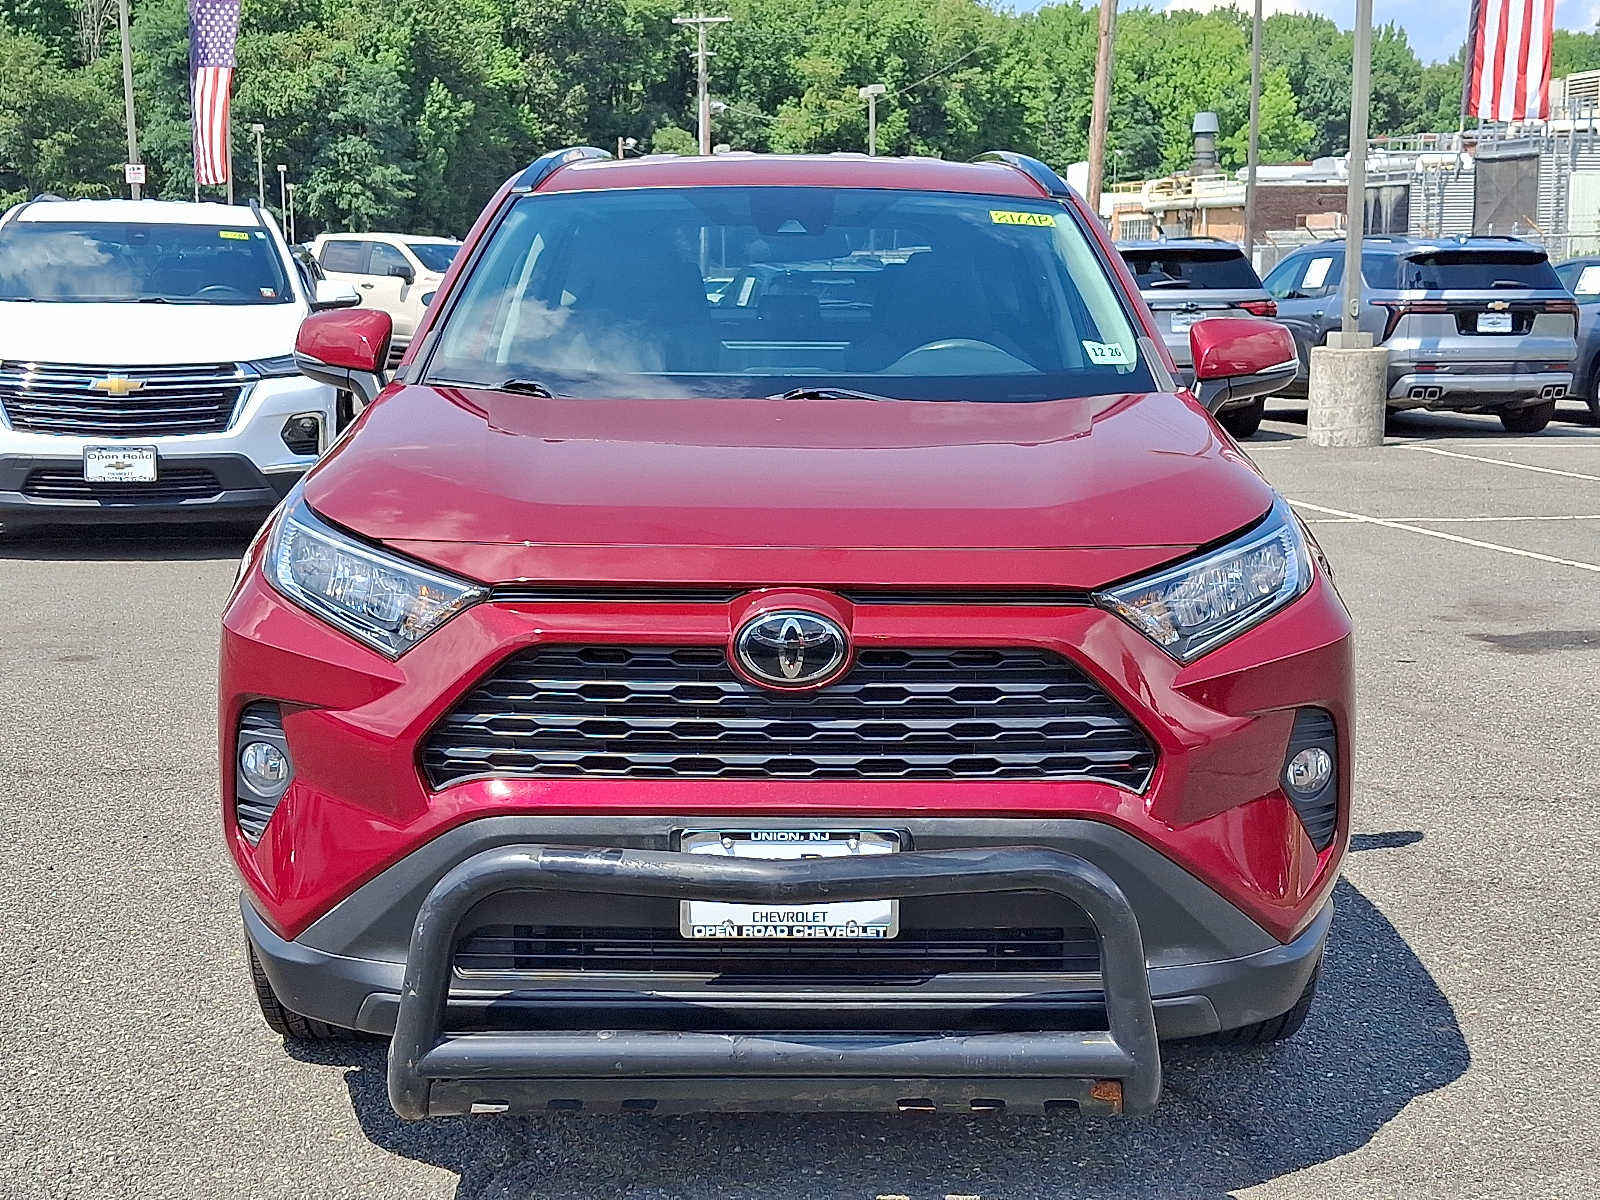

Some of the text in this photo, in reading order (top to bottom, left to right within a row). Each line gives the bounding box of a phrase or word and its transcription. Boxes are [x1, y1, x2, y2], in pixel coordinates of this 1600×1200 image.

[1092, 348, 1106, 356] 12
[87, 453, 119, 461] Open
[751, 831, 830, 841] UNION, NJ
[752, 911, 829, 923] CHEVROLET
[693, 925, 887, 937] OPEN ROAD CHEVROLET
